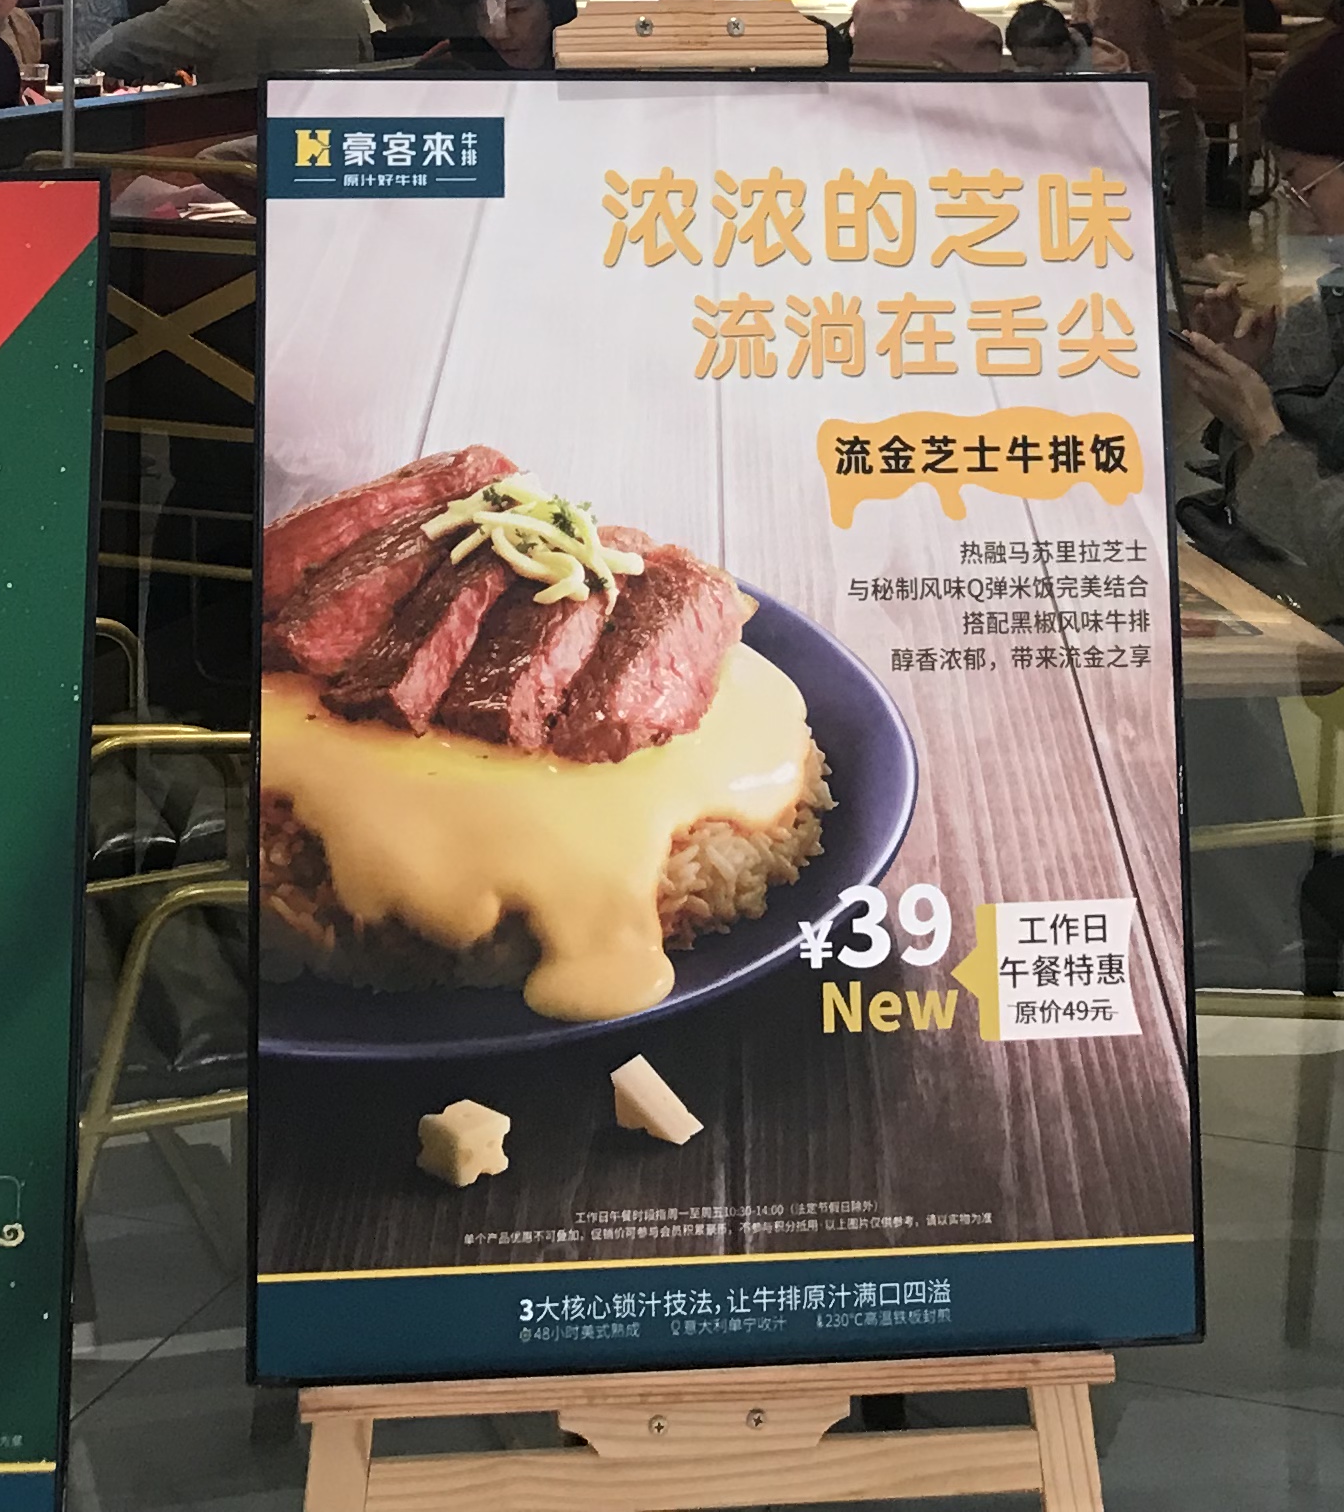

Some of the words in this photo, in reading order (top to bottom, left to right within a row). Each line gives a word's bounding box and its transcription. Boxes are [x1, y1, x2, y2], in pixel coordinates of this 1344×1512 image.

[342, 131, 456, 167] 豪客來
[460, 131, 478, 167] 牛排
[343, 173, 428, 187] 原汁好牛排
[602, 167, 1134, 268] 浓浓的芝味
[692, 292, 1141, 379] 流淌在舌尖
[834, 434, 1129, 476] 流金芝士牛排饭
[959, 540, 1148, 565] 热融马苏里拉芝士
[847, 574, 1150, 603] 与秘制风味Q弹米饭完美结合
[961, 610, 1152, 636] 搭配黑椒风味牛排
[1017, 913, 1109, 945] 工作日
[999, 953, 1126, 989] 午餐特惠
[822, 980, 959, 1034] New
[1014, 999, 1114, 1025] 原价49元
